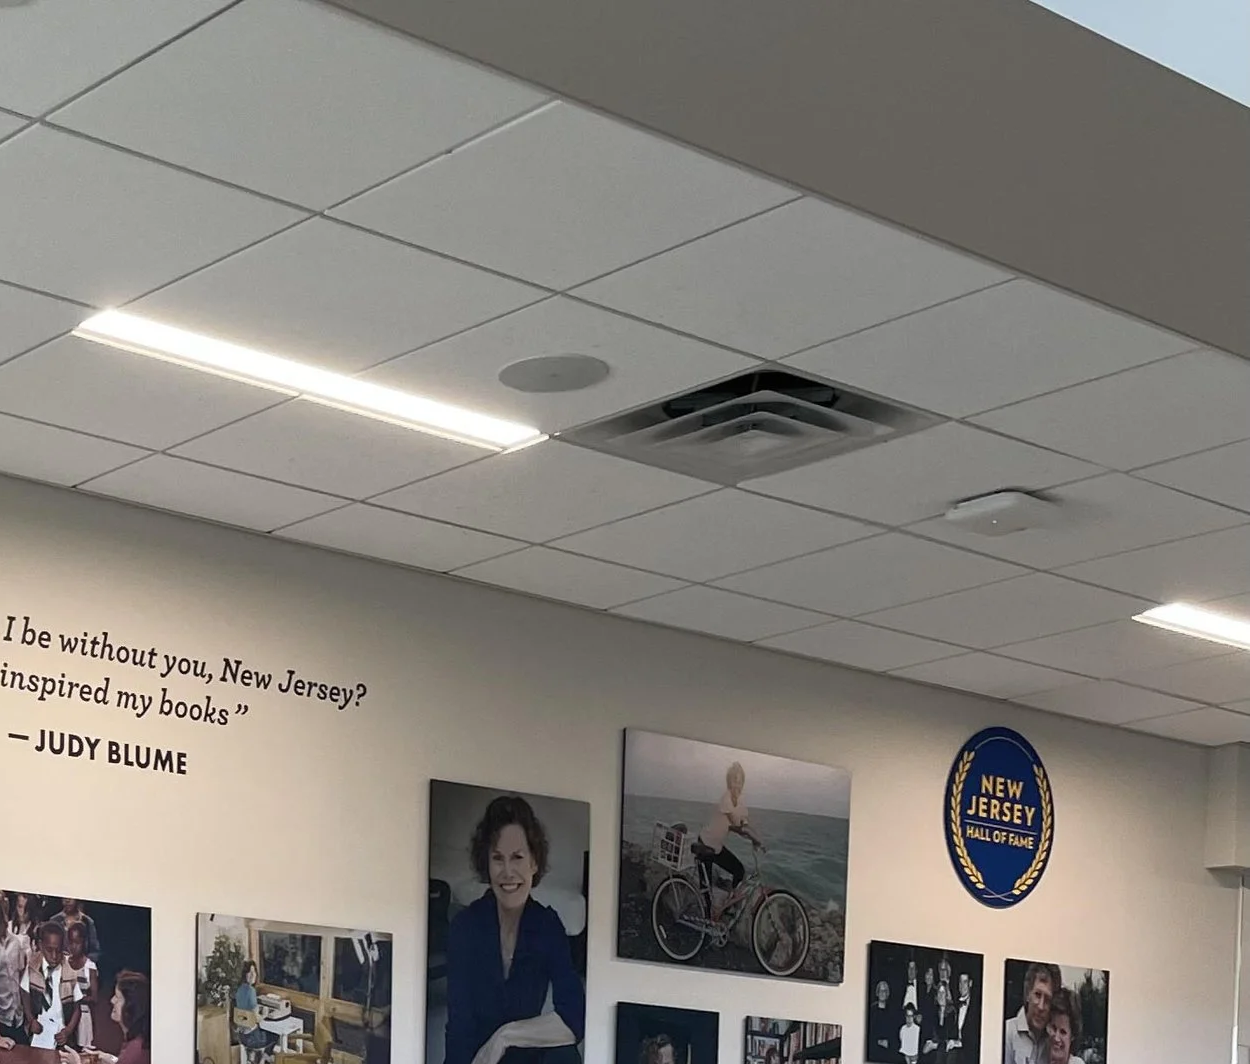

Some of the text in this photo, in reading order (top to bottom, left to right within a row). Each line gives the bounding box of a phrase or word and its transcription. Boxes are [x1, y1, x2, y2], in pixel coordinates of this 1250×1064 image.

[3, 615, 16, 642] I
[21, 616, 51, 649] be
[58, 631, 158, 670] without
[160, 653, 213, 684] you,
[219, 657, 272, 690] New
[278, 669, 367, 711] Jersey?
[0, 662, 111, 706] inspired
[116, 689, 153, 719] my
[35, 728, 101, 761] JUDY
[107, 740, 188, 775] BLUME
[981, 773, 1024, 801] NEW
[966, 795, 1036, 827] JERSEY
[966, 825, 1035, 850] HALL OF FAME
